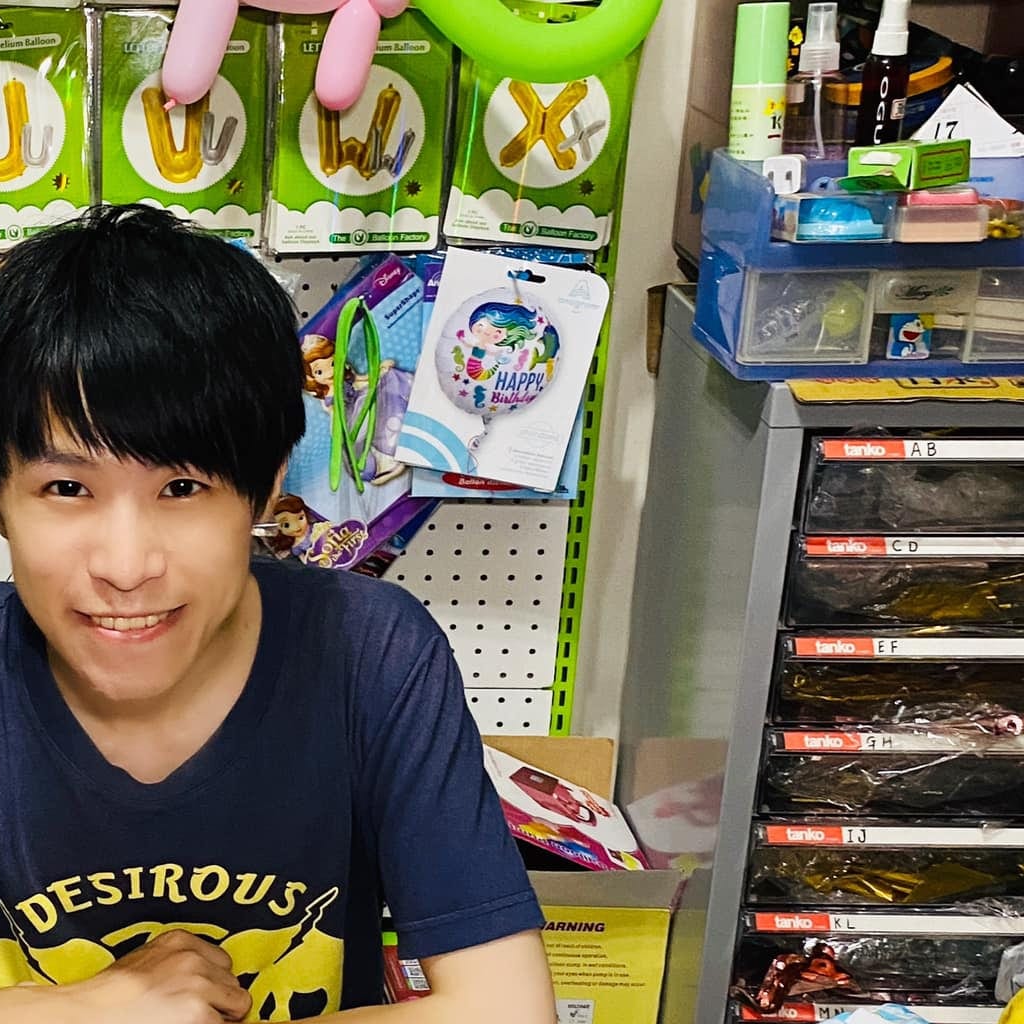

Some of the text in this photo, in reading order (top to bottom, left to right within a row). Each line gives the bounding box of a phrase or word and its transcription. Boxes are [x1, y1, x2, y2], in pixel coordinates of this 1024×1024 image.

[25, 38, 56, 47] Balloon
[394, 43, 425, 51] Balloon
[333, 232, 428, 242] The Balloon Factory
[568, 230, 595, 240] Factory
[495, 371, 543, 391] HAPPY
[844, 443, 886, 456] tanko
[826, 541, 867, 553] tanko
[815, 640, 856, 654] tanko
[804, 735, 843, 748] tanko
[786, 829, 825, 841] tanko
[16, 864, 307, 934] DESIROUS
[541, 921, 605, 932] ARNING
[774, 915, 813, 929] tanko
